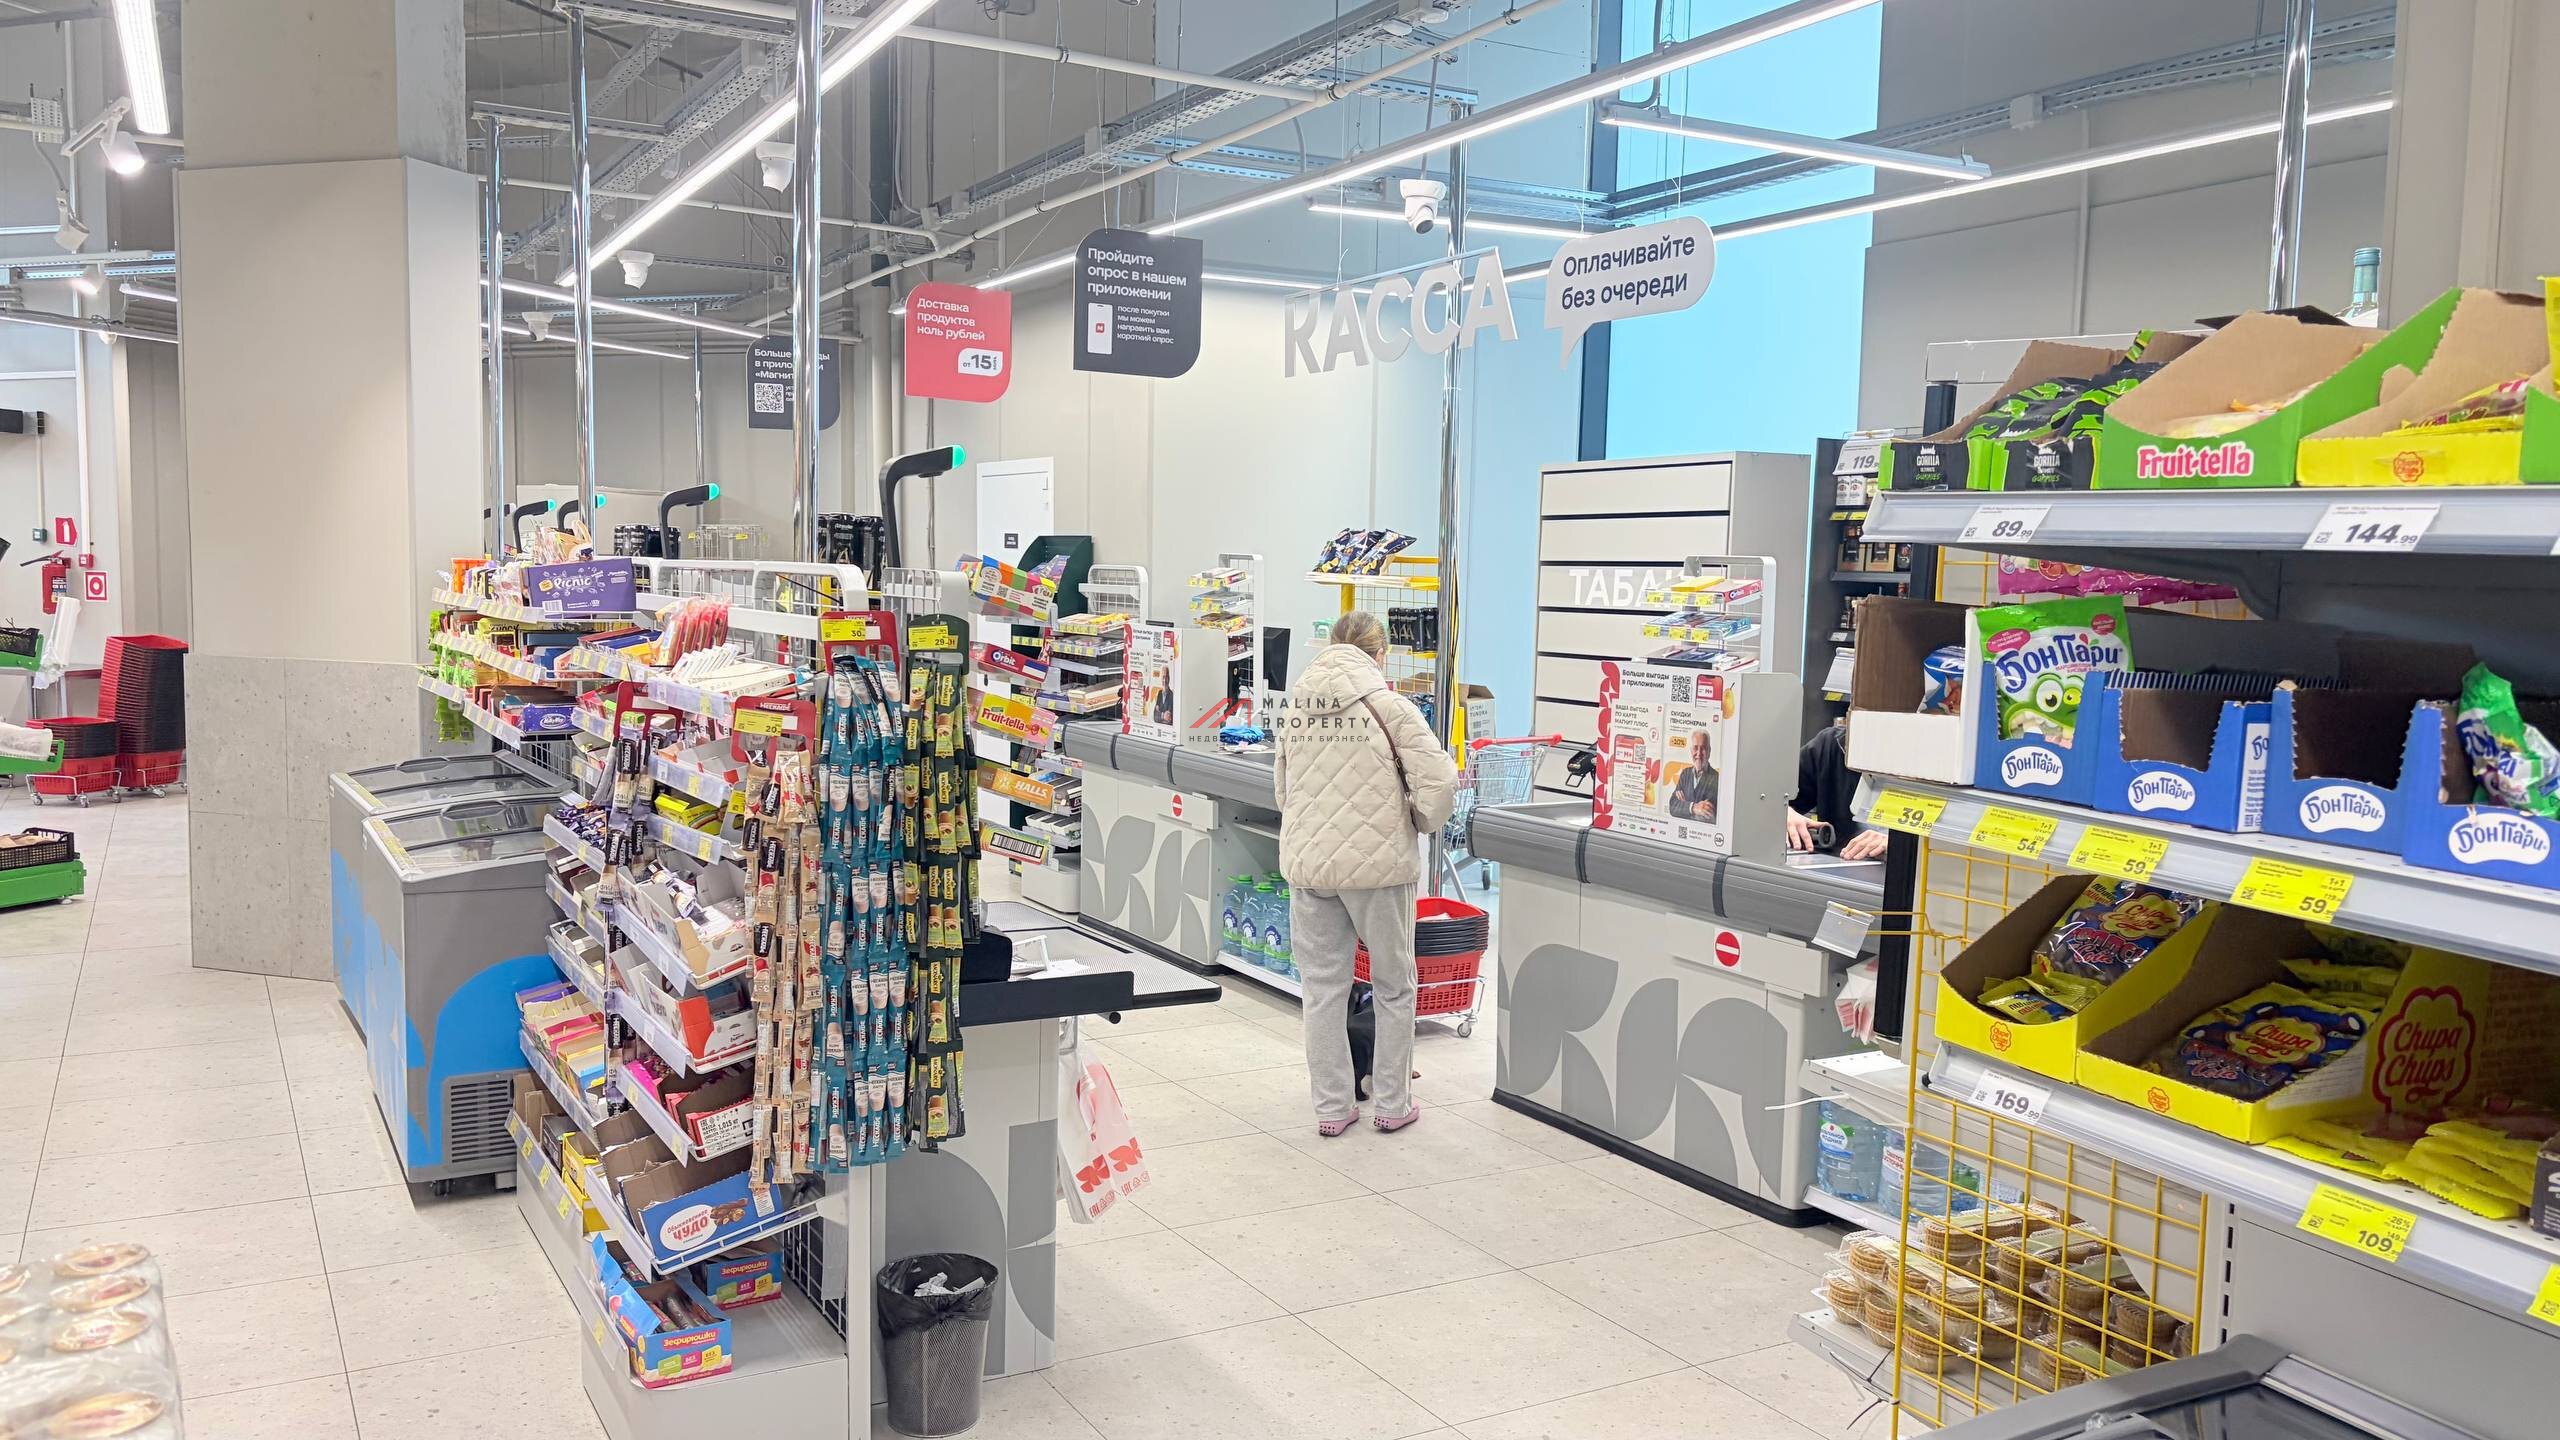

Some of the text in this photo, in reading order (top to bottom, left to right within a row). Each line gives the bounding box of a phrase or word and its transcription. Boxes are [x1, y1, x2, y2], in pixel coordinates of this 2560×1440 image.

[1088, 247, 1154, 266] Пройдите
[1563, 236, 1695, 278] Оплачивайте
[1088, 266, 1186, 286] опрос в нашем
[1088, 283, 1171, 300] приложении
[1561, 272, 1688, 310] без очереди
[917, 298, 969, 313] Доставка
[1117, 305, 1170, 317] после покупки
[1285, 248, 1518, 378] КАССА
[917, 312, 975, 327] продуктов
[1130, 316, 1156, 324] можем
[917, 326, 985, 340] ноль рублей
[1117, 324, 1155, 334] направить
[1117, 333, 1174, 344] короткий опрос
[754, 348, 792, 358] Больше
[971, 354, 992, 370] 15
[1916, 455, 1940, 466] GORILLA
[2034, 455, 2060, 466] GORILLA
[2138, 445, 2253, 478] Fruit-tella
[1992, 520, 2032, 538] 89.99
[2345, 524, 2418, 544] 144.99
[554, 576, 592, 590] Picnic
[992, 651, 1016, 666] Orbit
[1622, 669, 1670, 682] Больше выгоды
[1627, 680, 1665, 690] приложении
[981, 708, 1025, 731] Fruit-tella
[1671, 710, 1692, 718] СКИДКИ
[1015, 781, 1048, 797] HALLS
[1898, 807, 1933, 830] 39.99
[2329, 878, 2346, 887] 1+1
[2256, 1025, 2315, 1051] Chupa
[2394, 1022, 2463, 1059] Chupa
[2385, 1054, 2456, 1088] Chups
[1994, 1089, 2040, 1120] 169.99
[673, 1216, 709, 1241] ЧУДО
[721, 1261, 769, 1276] Зефирюшки
[663, 1331, 717, 1348] Зефирюшки
